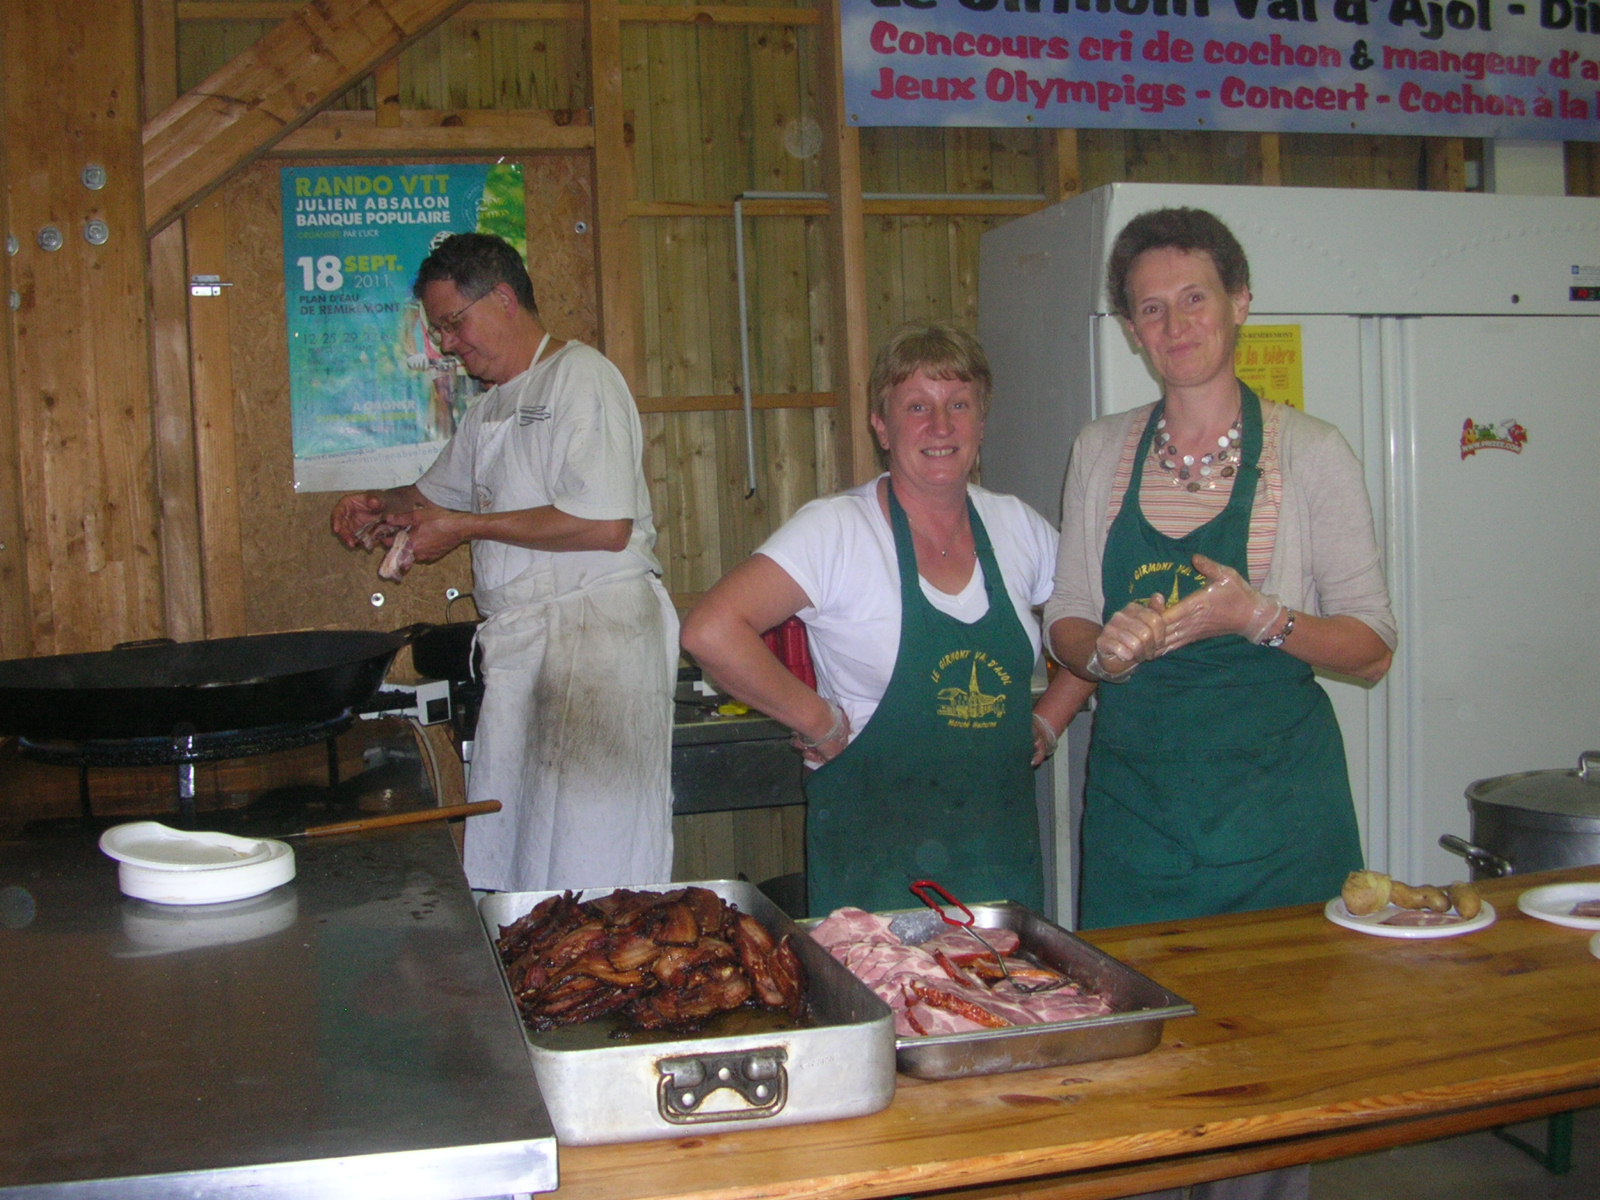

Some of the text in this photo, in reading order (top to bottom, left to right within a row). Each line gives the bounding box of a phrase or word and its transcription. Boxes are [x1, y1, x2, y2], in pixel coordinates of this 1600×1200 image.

[1333, 0, 1492, 40] dAjol
[870, 20, 1600, 82] Concours cri de cochon & mangeur d'a
[870, 67, 976, 100] Jeux
[986, 68, 1187, 113] Olympigs
[1220, 75, 1369, 111] Concert
[1398, 81, 1527, 116] Cochon
[1532, 86, 1553, 118] à
[1558, 89, 1589, 119] la
[295, 174, 451, 197] RANDO VTT
[296, 196, 450, 212] JULIEN ABSALON
[296, 210, 451, 227] BANQUE POPULAIRE
[345, 255, 404, 273] SEPT.
[296, 255, 344, 293] 18
[354, 274, 390, 289] 2011
[299, 293, 360, 304] PLAN D'EAU
[300, 305, 315, 316] DE
[1134, 562, 1174, 580] GIRMONT
[931, 669, 941, 684] LE
[939, 650, 971, 670] GIRMONT
